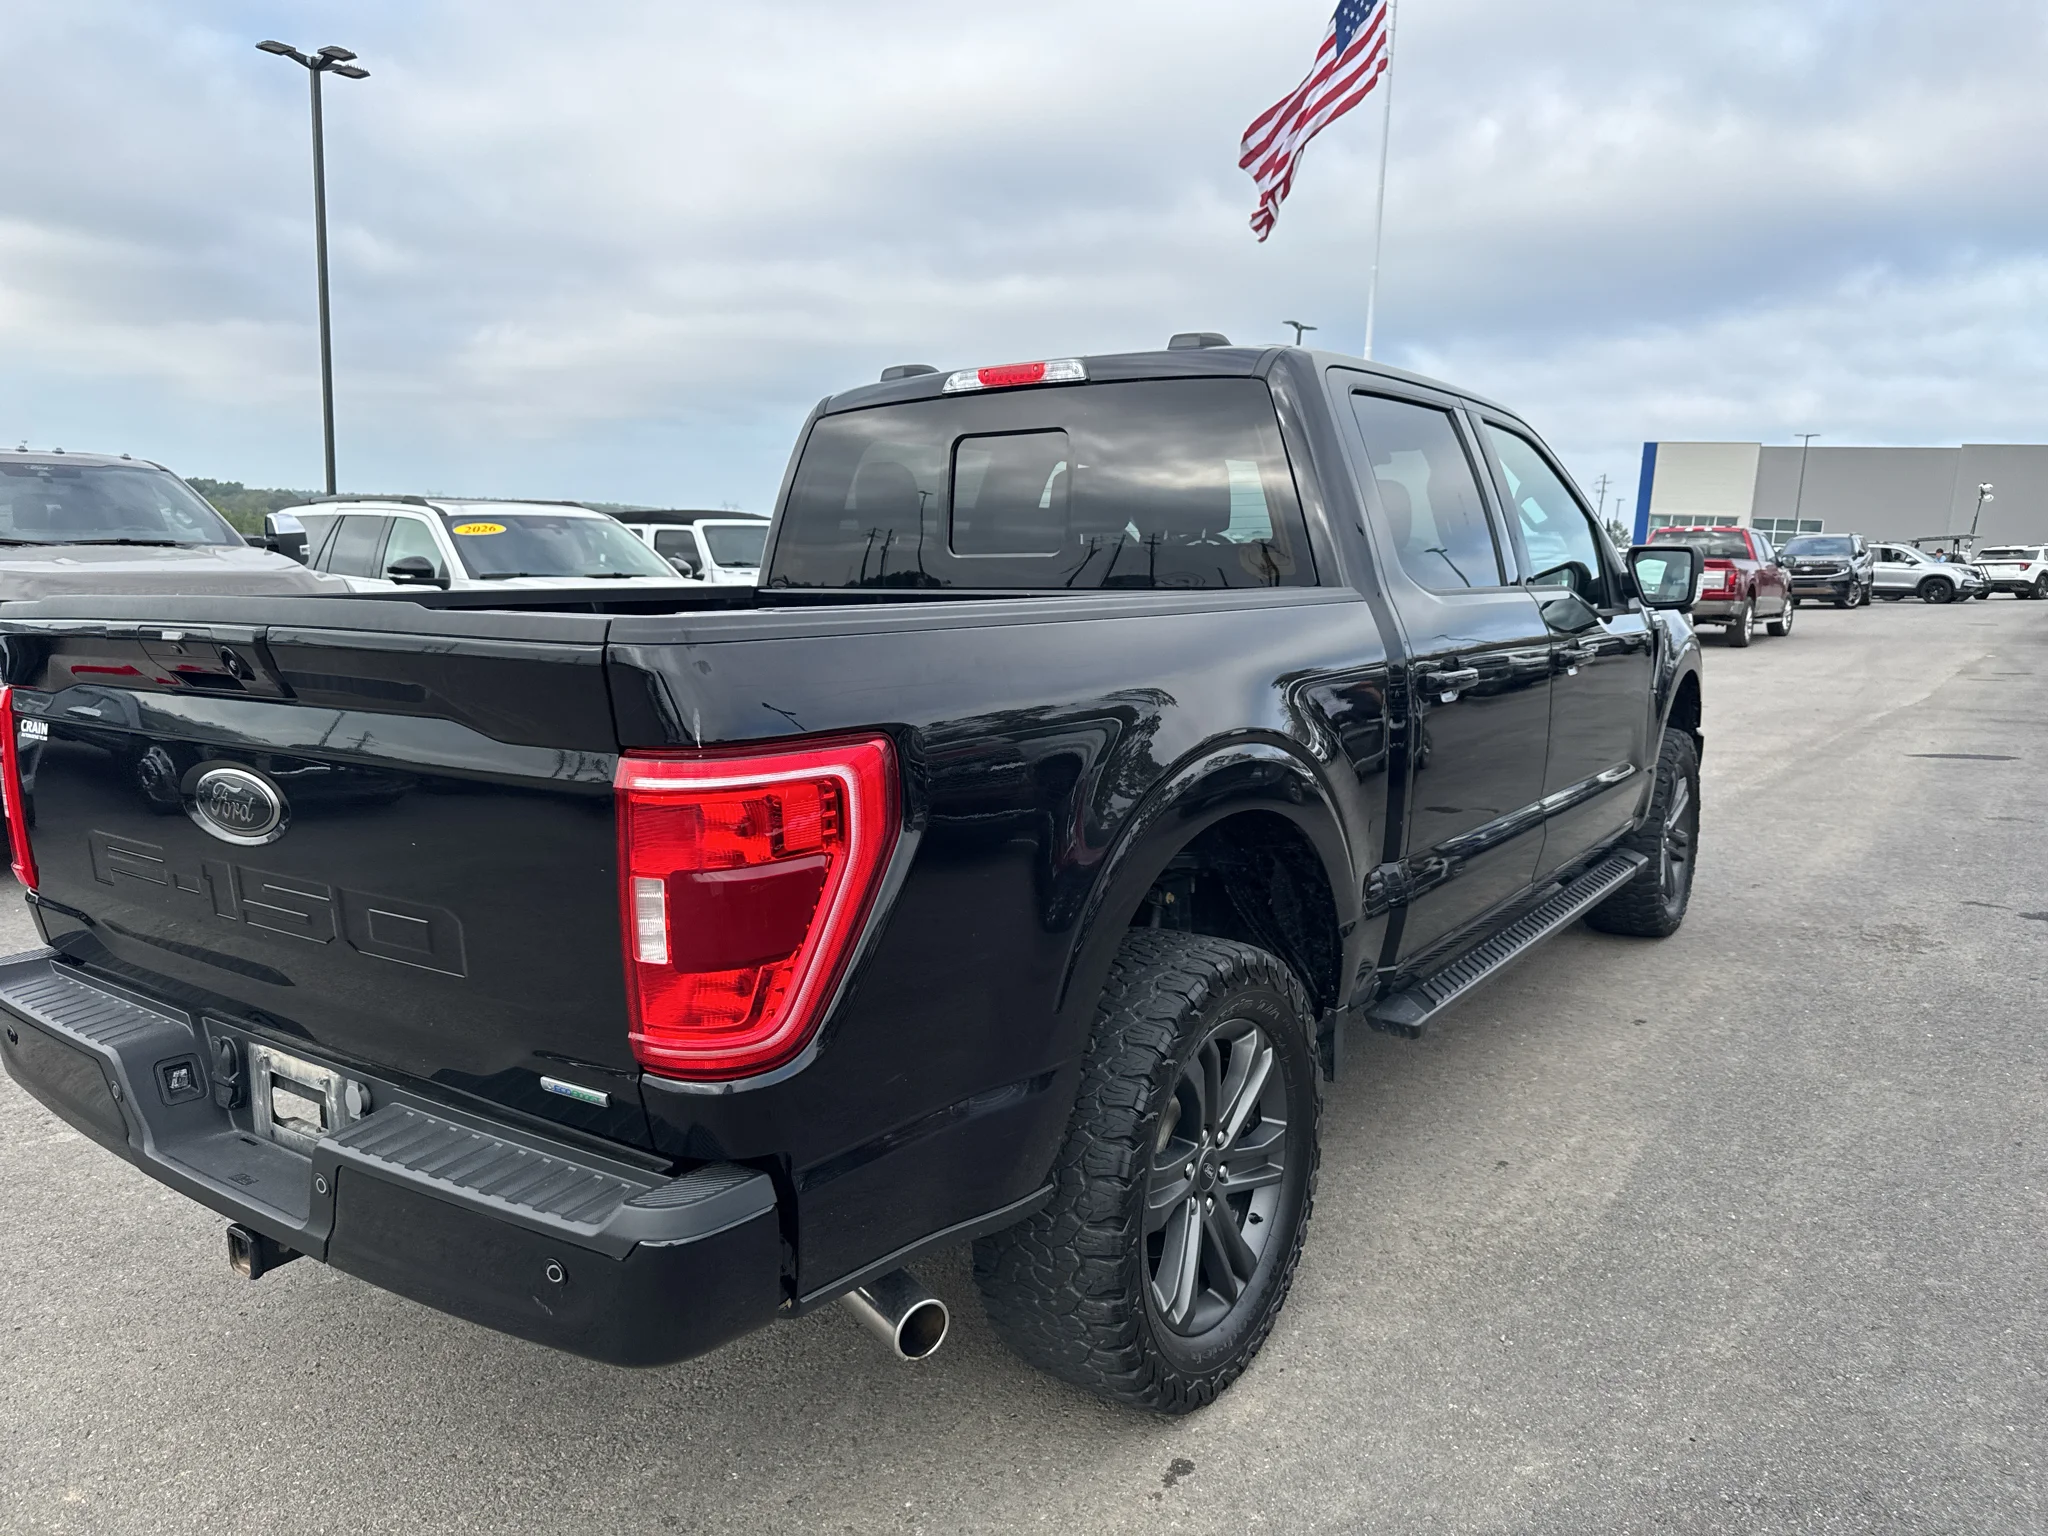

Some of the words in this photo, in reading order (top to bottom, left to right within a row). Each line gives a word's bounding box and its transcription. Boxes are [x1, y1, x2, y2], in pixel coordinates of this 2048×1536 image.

[464, 525, 497, 534] 2026
[20, 719, 49, 736] CRAIN
[210, 781, 255, 823] Ford
[88, 828, 468, 979] F-150
